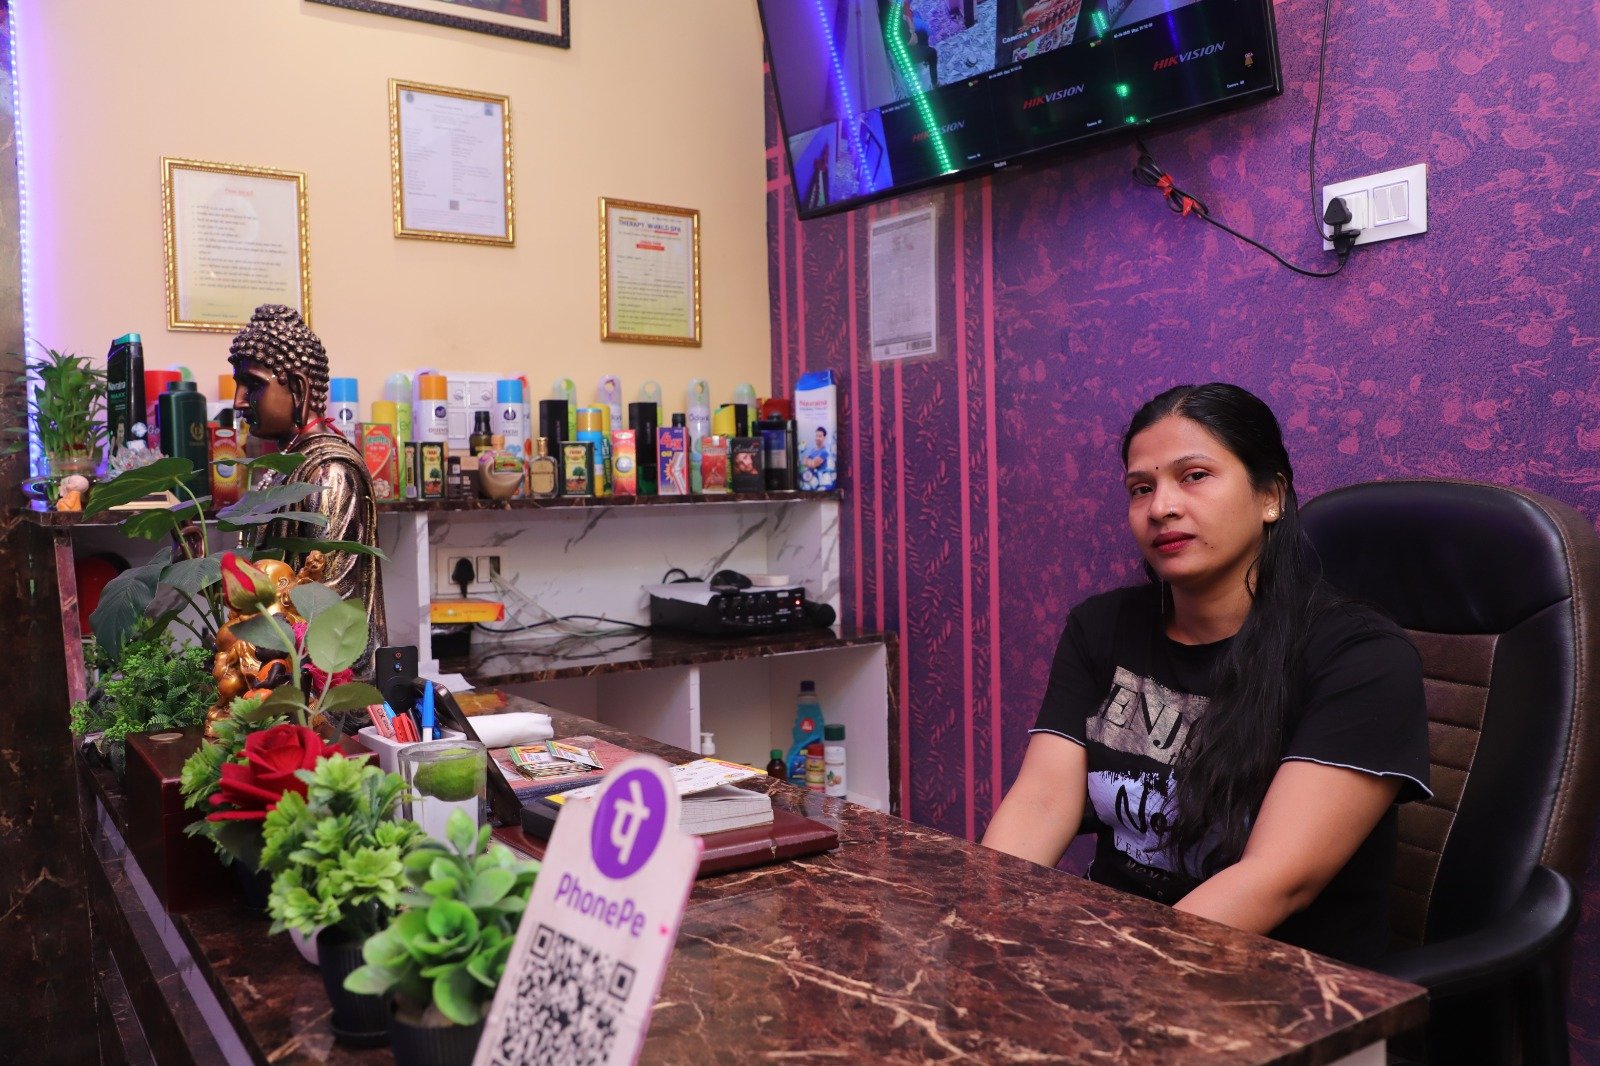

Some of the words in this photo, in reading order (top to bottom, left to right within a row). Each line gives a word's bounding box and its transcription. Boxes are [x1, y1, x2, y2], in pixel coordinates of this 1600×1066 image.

[1002, 31, 1028, 44] Camera
[1030, 26, 1040, 34] 01
[1152, 40, 1226, 71] HIKVISION
[1023, 83, 1085, 110] HIKVISION
[912, 119, 965, 144] HIKSION
[554, 871, 646, 938] PhonePe
